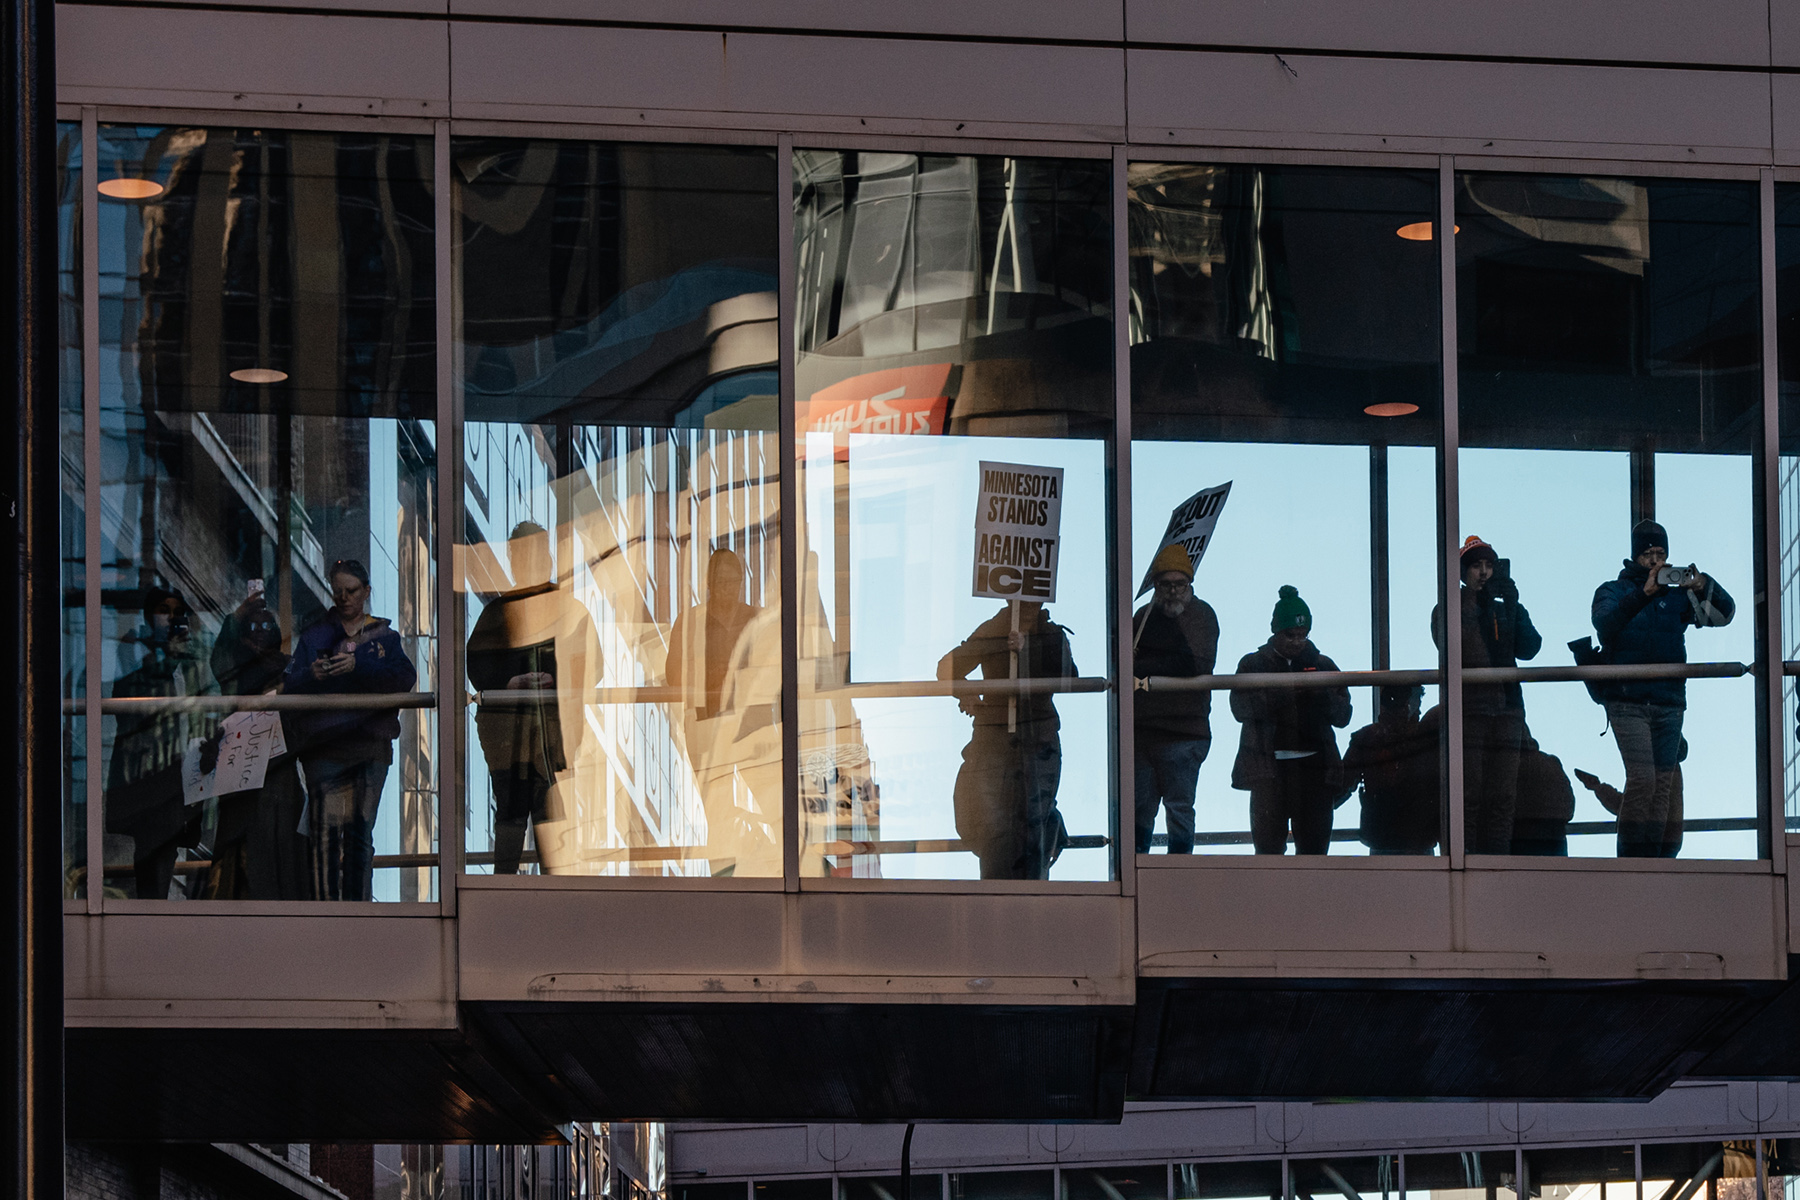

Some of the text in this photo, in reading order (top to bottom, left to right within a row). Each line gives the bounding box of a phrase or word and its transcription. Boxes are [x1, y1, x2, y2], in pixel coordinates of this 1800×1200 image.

[983, 469, 1058, 499] MINNESOTA
[987, 495, 1048, 527] STANDS
[1185, 490, 1226, 523] OUT
[1173, 522, 1195, 538] OF
[978, 533, 1055, 569] AGAINST
[976, 564, 1052, 597] ICE
